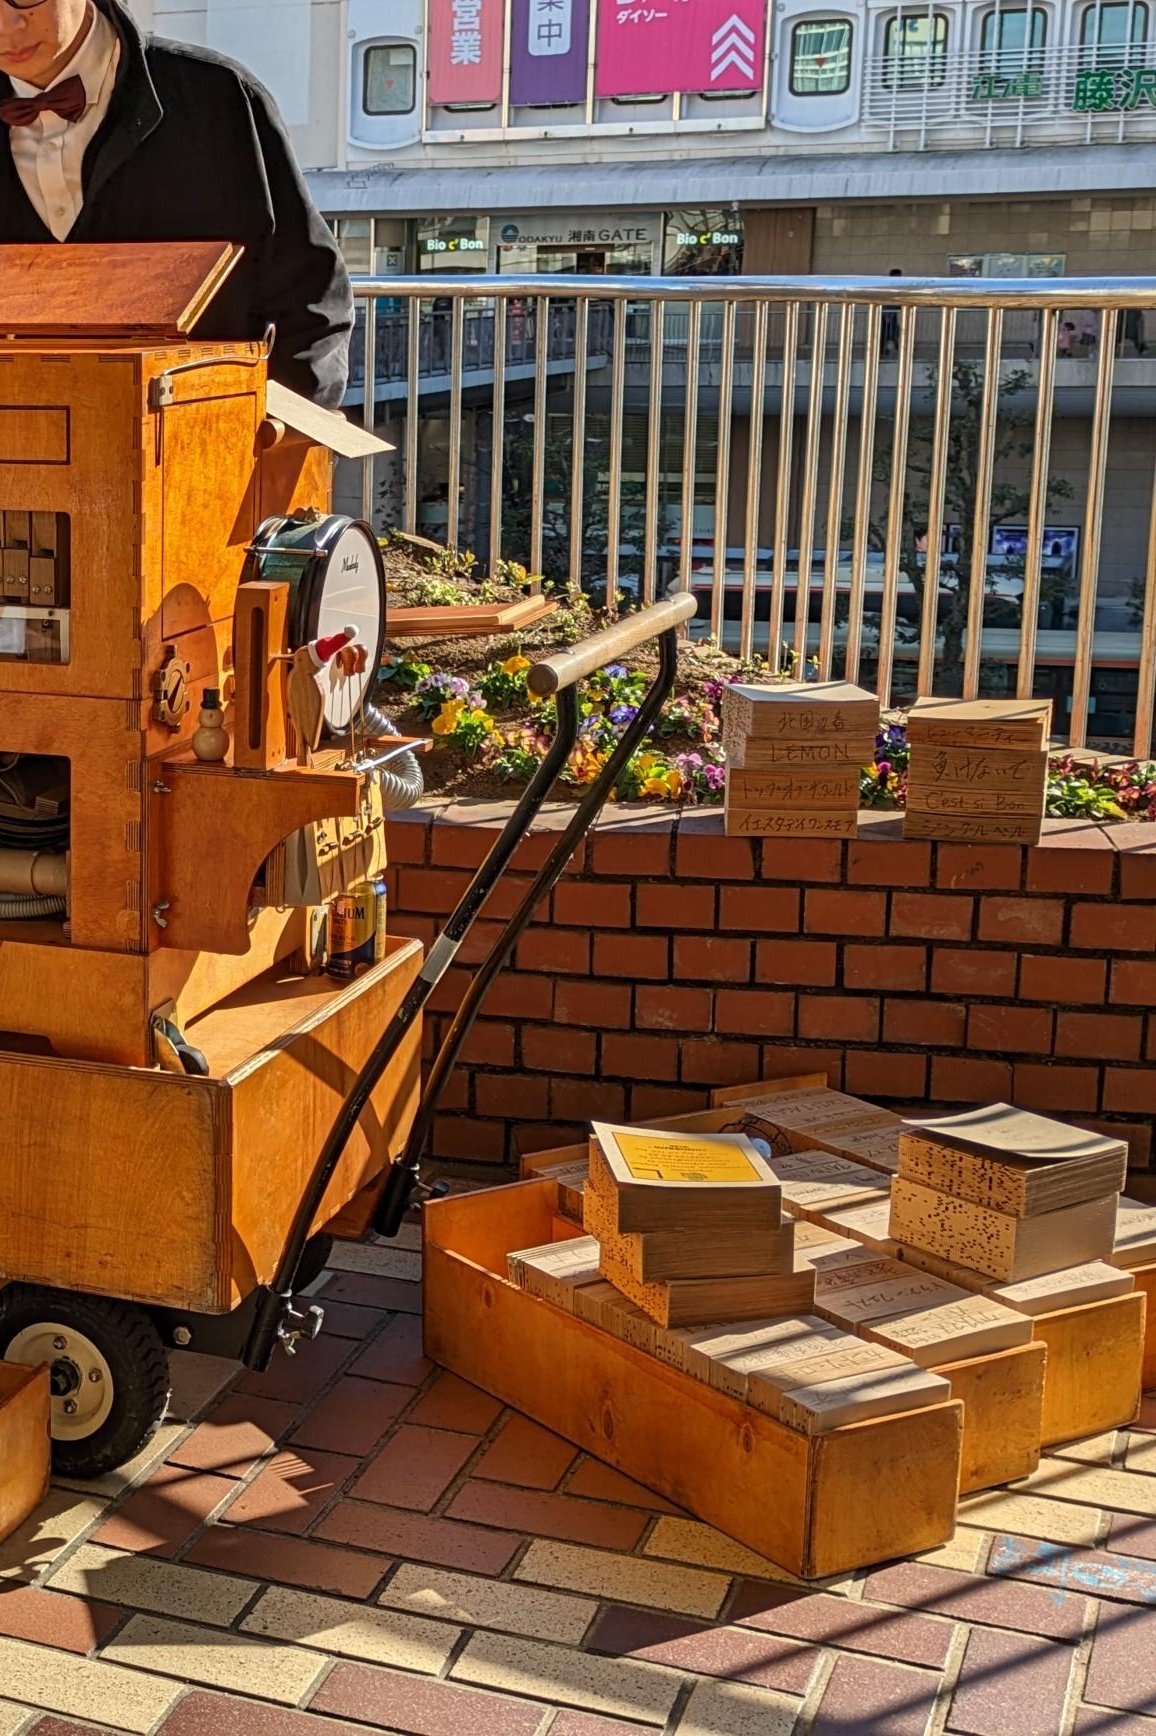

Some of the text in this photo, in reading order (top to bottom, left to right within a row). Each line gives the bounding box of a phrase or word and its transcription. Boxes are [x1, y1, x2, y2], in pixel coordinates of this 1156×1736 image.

[616, 11, 668, 25] ダイソー
[971, 73, 1042, 100] 江ノ電
[518, 228, 648, 244] ODAKYU 湘南 GATE
[676, 232, 698, 245] Bio
[712, 231, 739, 244] Bon
[426, 239, 447, 251] Bio
[459, 238, 484, 250] Bon
[771, 743, 850, 763] LEMON
[925, 791, 964, 810] C'est
